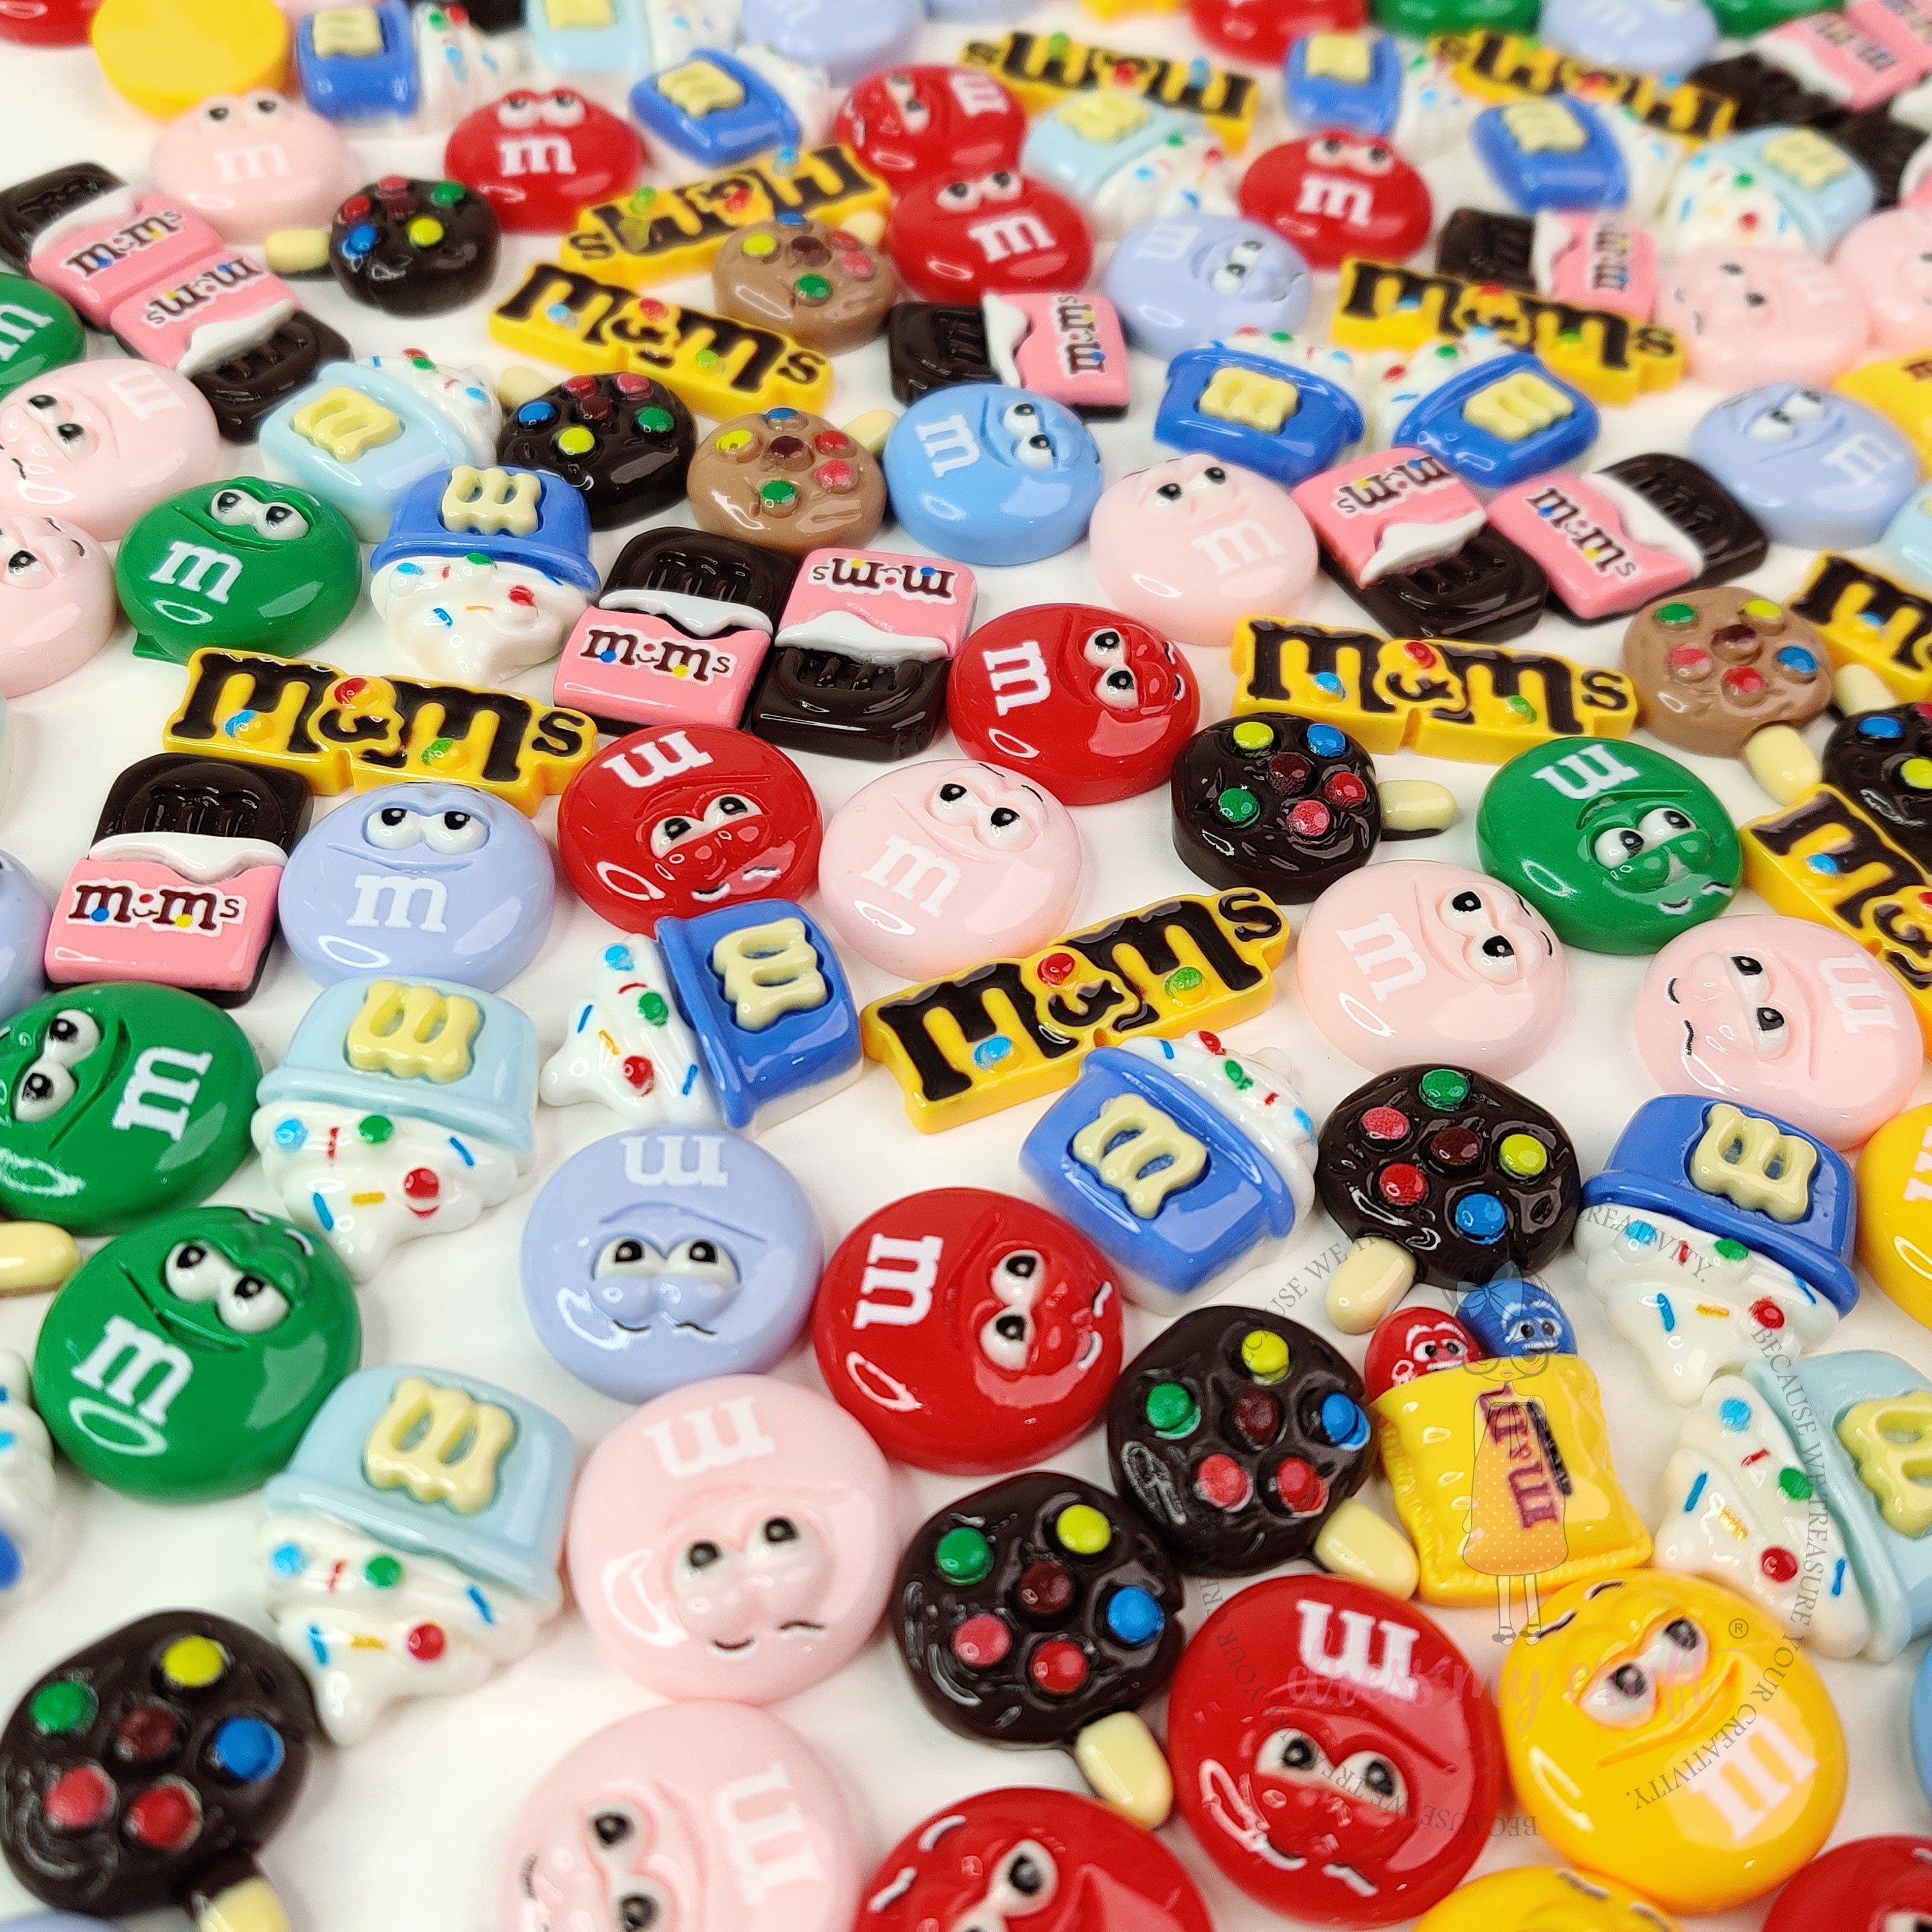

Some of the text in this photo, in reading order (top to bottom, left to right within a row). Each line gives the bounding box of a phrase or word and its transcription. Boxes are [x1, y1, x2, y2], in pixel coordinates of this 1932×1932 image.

[213, 142, 292, 184] m
[501, 134, 576, 177] m
[968, 214, 1056, 263] m
[1295, 176, 1376, 226] m
[1136, 222, 1203, 260] m
[106, 366, 186, 421] m
[293, 386, 402, 462] m
[916, 414, 980, 479] m
[1821, 433, 1904, 485] m
[442, 466, 541, 536] m
[148, 540, 245, 605] m
[1191, 519, 1285, 576] m
[982, 639, 1052, 717] m
[601, 729, 714, 789] m
[1531, 743, 1642, 800] m
[346, 875, 450, 933] m
[860, 834, 964, 916] m
[712, 917, 828, 1030] m
[1335, 912, 1428, 1003] m
[1818, 953, 1899, 1033] m
[346, 979, 484, 1084] m
[111, 1045, 214, 1142] m
[618, 1134, 729, 1188] m
[1072, 1092, 1209, 1220] m
[1689, 1101, 1819, 1225] m
[853, 1233, 945, 1331] m
[70, 1314, 194, 1428] m
[365, 1377, 516, 1515] m
[646, 1396, 773, 1477] m
[1296, 1598, 1421, 1700] m
[1691, 1712, 1820, 1842] m
[715, 1759, 826, 1905] m
